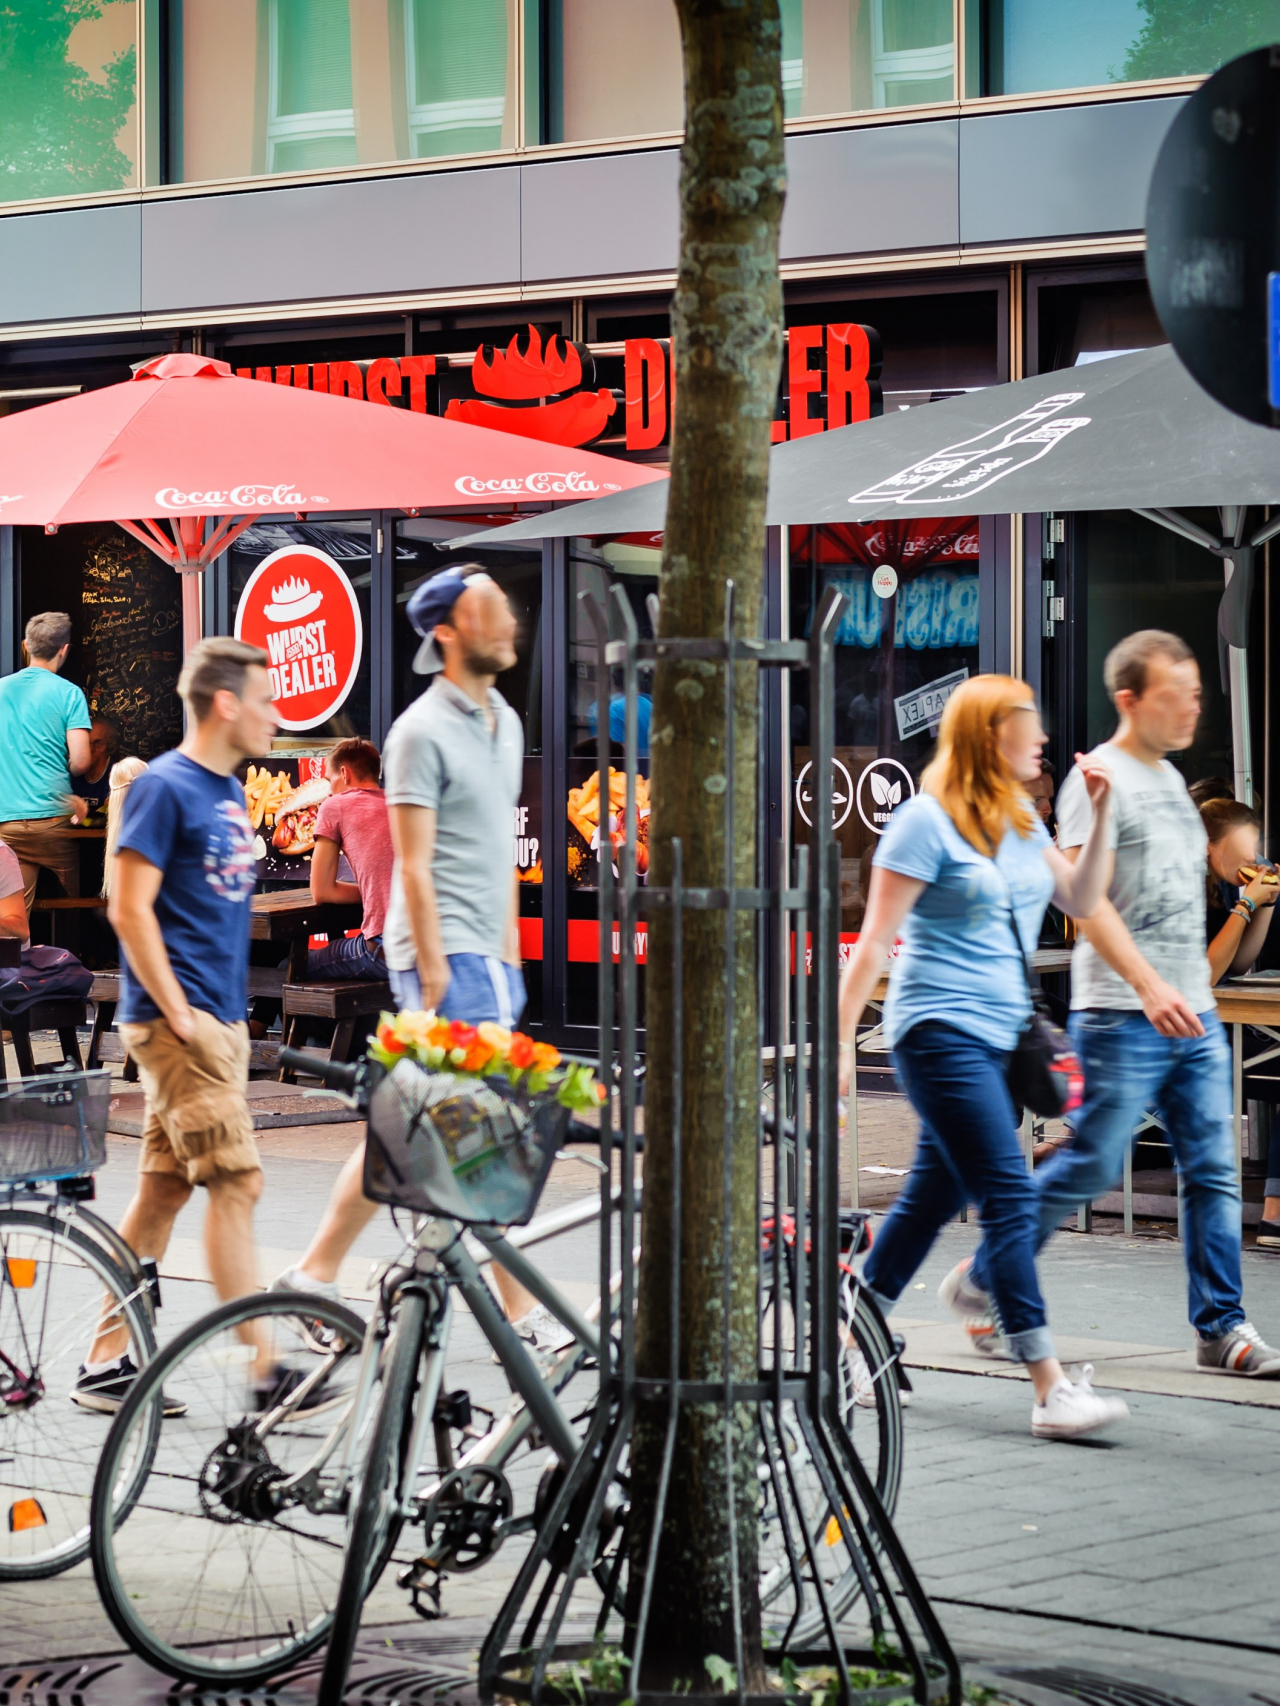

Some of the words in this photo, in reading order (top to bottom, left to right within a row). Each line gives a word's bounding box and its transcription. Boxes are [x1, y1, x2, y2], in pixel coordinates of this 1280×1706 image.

[625, 322, 883, 451] DER
[155, 483, 307, 510] Coca-Cola
[455, 471, 599, 496] Coca-Cola
[266, 619, 327, 666] WURST
[267, 652, 338, 701] DEALER
